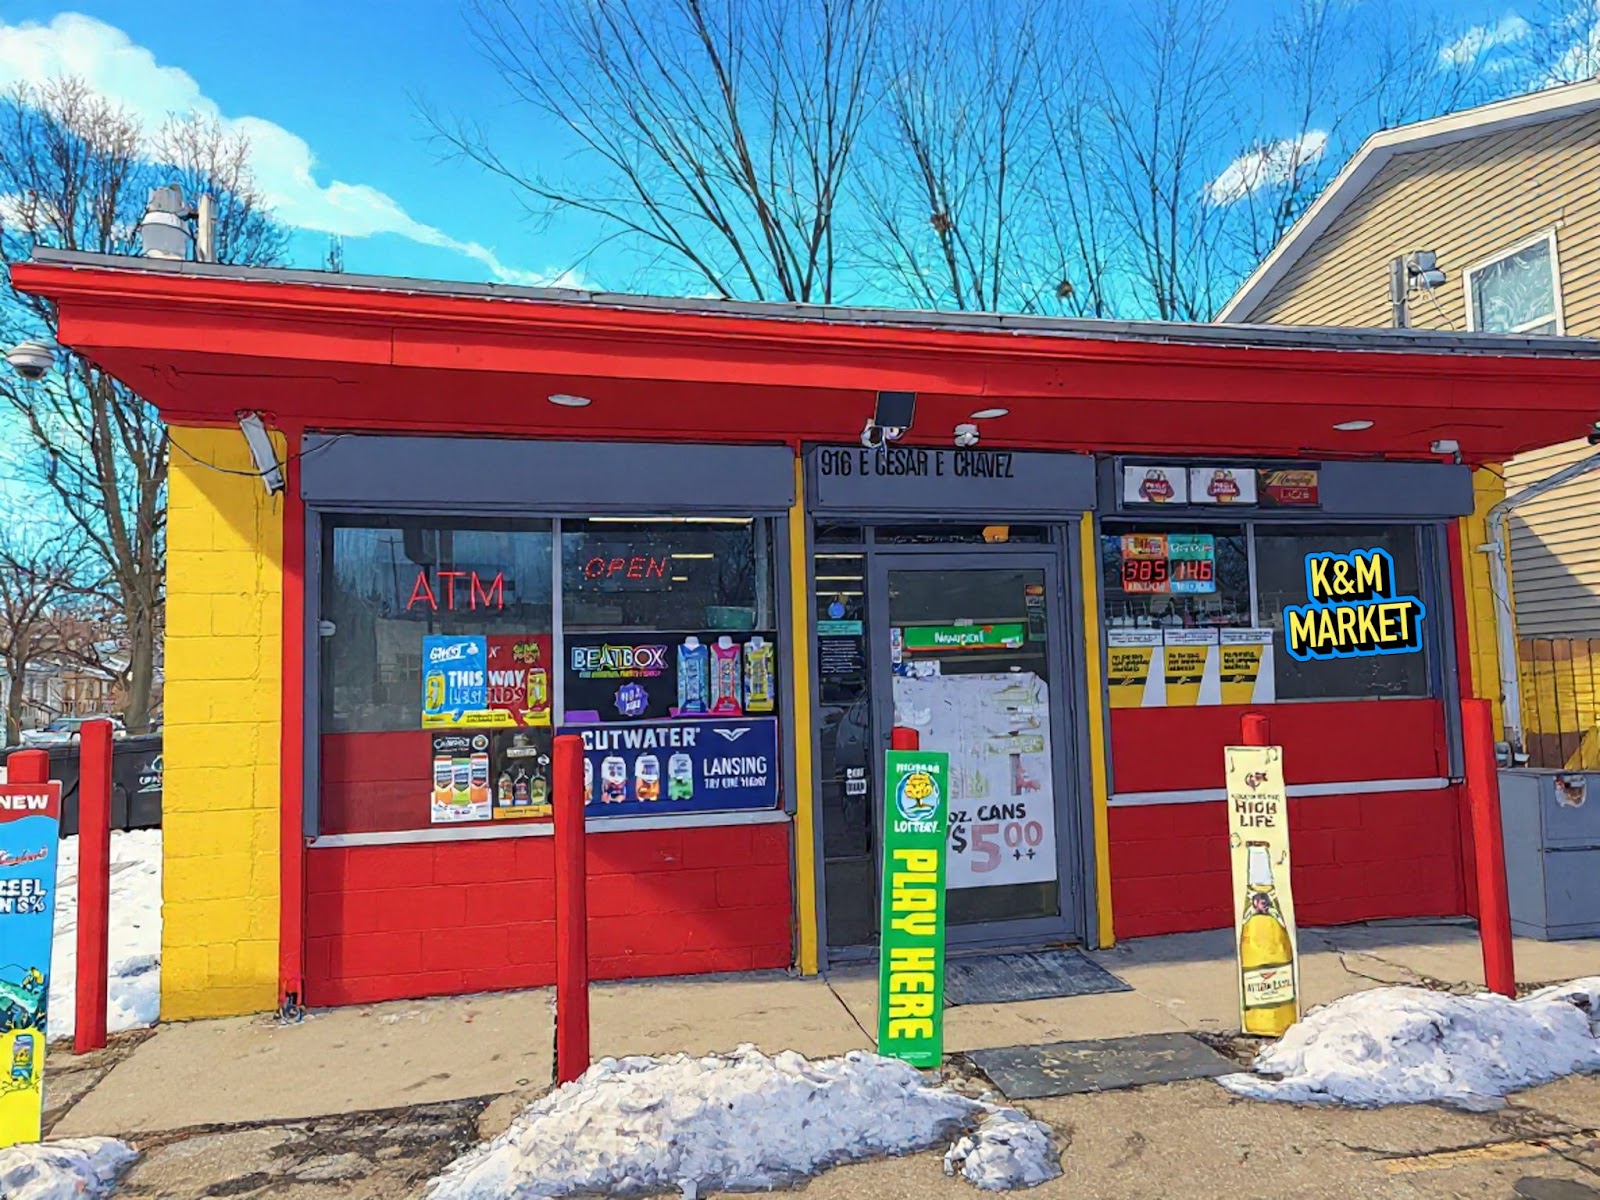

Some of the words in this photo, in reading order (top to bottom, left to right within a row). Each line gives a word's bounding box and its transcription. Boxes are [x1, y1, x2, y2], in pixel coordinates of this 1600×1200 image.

[820, 450, 851, 476] 916
[860, 450, 869, 476] E
[875, 450, 928, 477] CESAR
[935, 451, 944, 476] E
[953, 450, 1014, 478] CHAVEZ
[584, 556, 667, 579] OPEN
[1124, 560, 1166, 581] 385
[1178, 560, 1212, 581] 146
[406, 571, 504, 611] ATM
[571, 644, 669, 671] BEATBOX
[447, 670, 483, 687] THIS
[581, 727, 697, 750] CUTWATER
[703, 756, 767, 776] LANSING
[0, 795, 49, 810] NEW
[977, 803, 1028, 822] CANS
[894, 820, 937, 833] LOTTERY
[1240, 815, 1276, 828] LIFE
[890, 848, 938, 936] PLAY
[888, 947, 936, 1039] HERE
